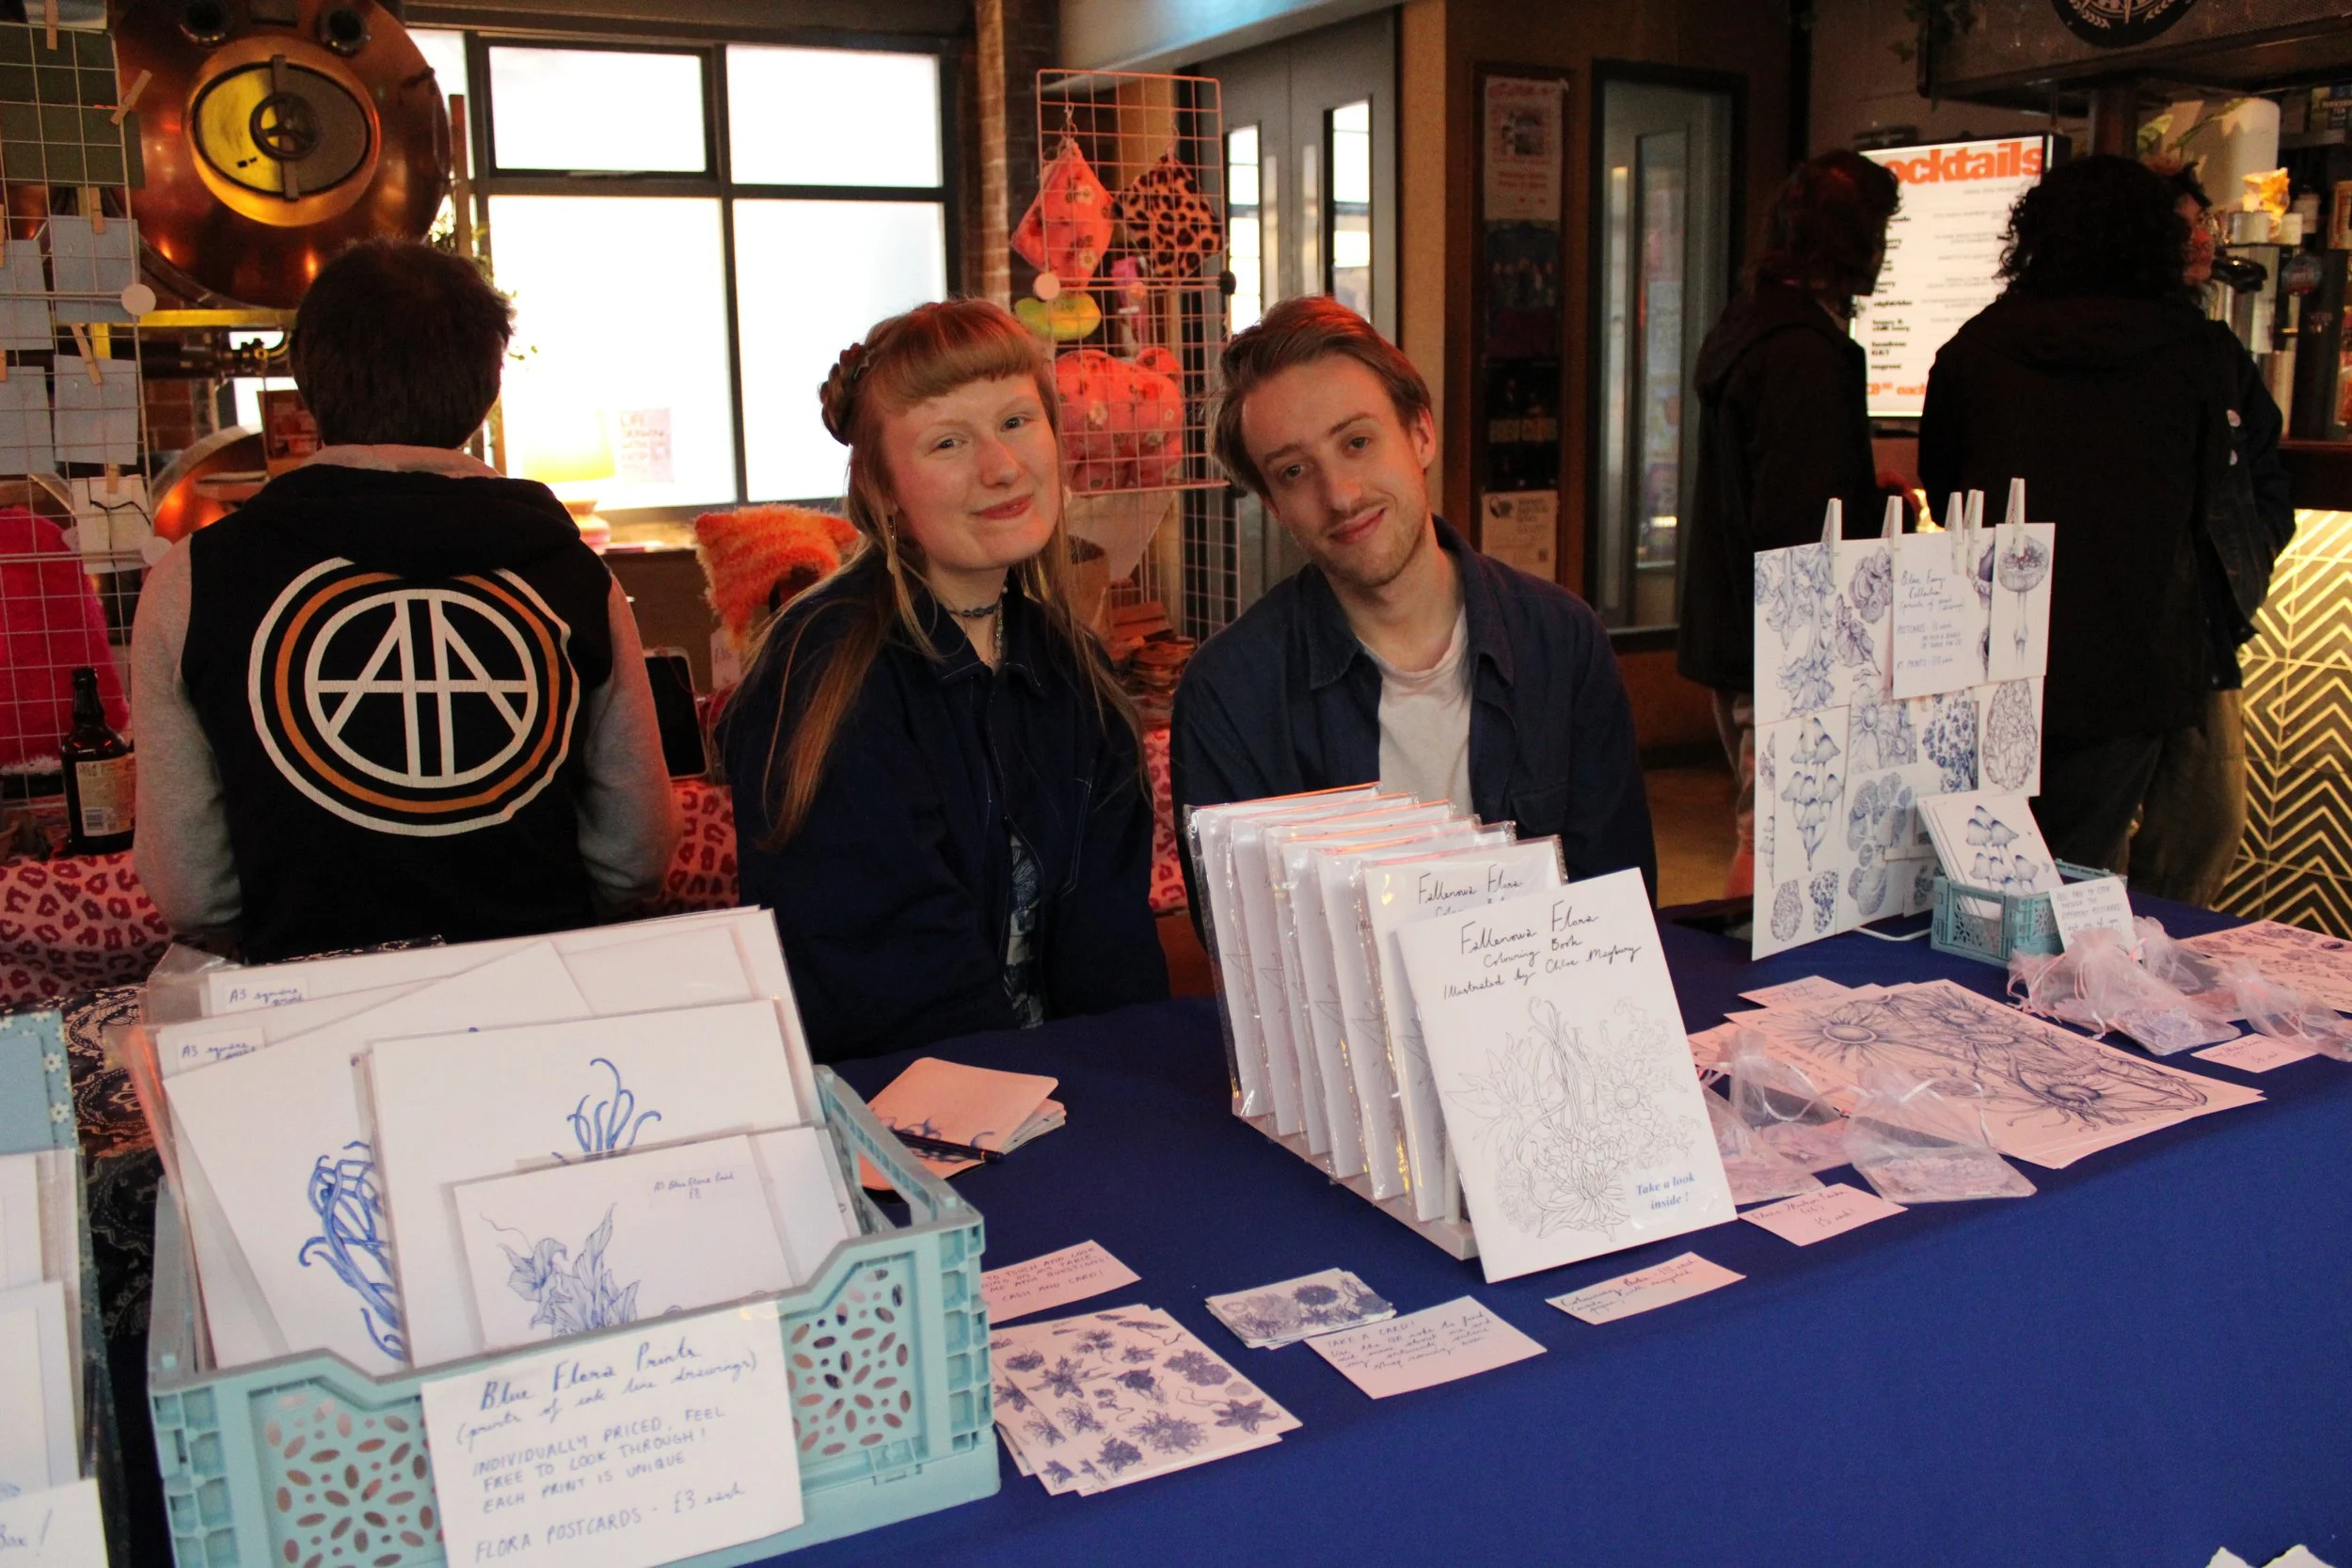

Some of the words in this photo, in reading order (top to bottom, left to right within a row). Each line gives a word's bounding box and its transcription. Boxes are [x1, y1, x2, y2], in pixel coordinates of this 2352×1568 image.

[1884, 141, 2042, 184] ocktails
[1902, 570, 1920, 586] Blue
[1487, 863, 1523, 893] Flora
[1551, 900, 1599, 932] Flora
[1484, 949, 1541, 968] Colouring
[1550, 935, 1582, 951] Book
[1443, 974, 1505, 1000] Illustrated
[1514, 968, 1535, 986] by
[1546, 958, 1579, 974] Chloe
[230, 989, 246, 1003] A3
[182, 1044, 199, 1059] A3
[1636, 1182, 1660, 1196] Take
[1673, 1172, 1695, 1186] look
[1651, 1195, 1681, 1210] inside
[1072, 1247, 1095, 1259] LOOK
[990, 1285, 1006, 1293] ME
[1002, 1291, 1031, 1302] CASH
[1039, 1283, 1060, 1292] AND
[1327, 1336, 1355, 1347] TAKE
[1331, 1348, 1347, 1358] Use
[1361, 1342, 1379, 1351] the
[1388, 1335, 1404, 1344] QR
[1409, 1327, 1435, 1338] code
[1463, 1311, 1486, 1326] find
[480, 1380, 533, 1412] Blue
[553, 1363, 617, 1393] Flora
[636, 1337, 702, 1372] Prints
[456, 1413, 521, 1453] (prints
[538, 1401, 564, 1422] of
[575, 1390, 606, 1407] ink
[622, 1379, 657, 1396] line
[671, 1352, 757, 1385] drawings)
[472, 1434, 589, 1477] INDIVIDUALLY
[685, 1408, 726, 1423] FEEL
[483, 1493, 526, 1514] EACH
[542, 1478, 585, 1497] PRINT
[597, 1470, 613, 1484] IS
[626, 1452, 686, 1480] UNIQUE
[484, 1471, 526, 1493] FREE
[534, 1464, 555, 1479] TO
[570, 1452, 607, 1471] LOOK
[474, 1533, 532, 1563] FLORA
[547, 1509, 643, 1544] POSTCARDS
[674, 1488, 698, 1514] £3
[705, 1481, 746, 1505] each
